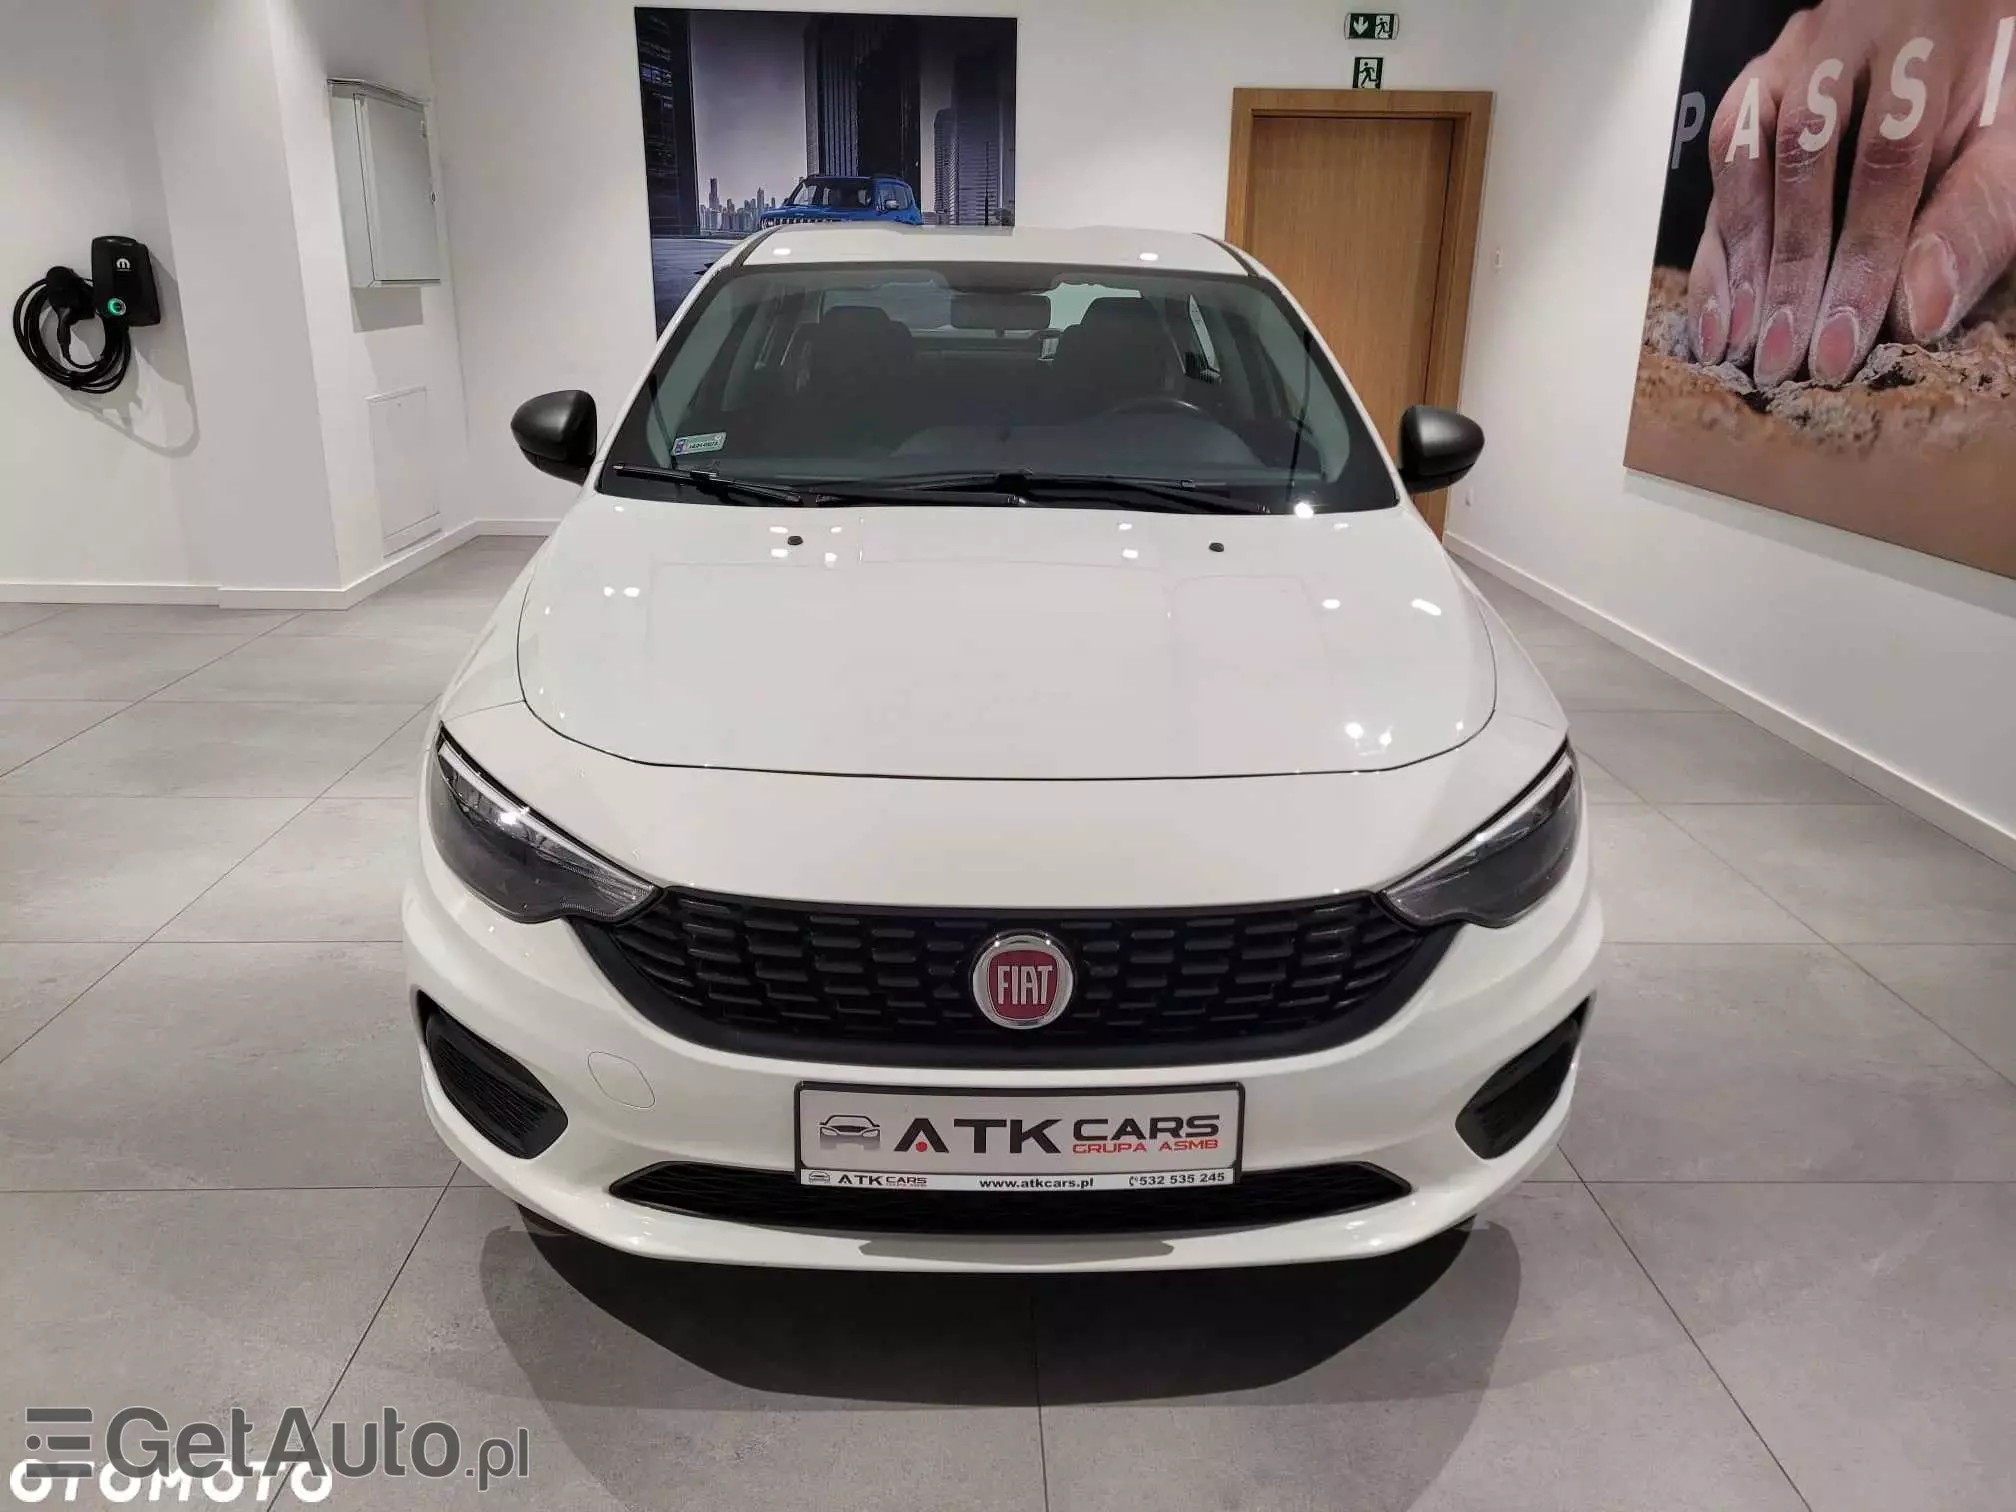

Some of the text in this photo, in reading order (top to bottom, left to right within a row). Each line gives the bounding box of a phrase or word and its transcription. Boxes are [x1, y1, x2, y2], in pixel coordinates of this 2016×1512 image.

[1671, 15, 2016, 170] PASSI
[997, 965, 1053, 1005] FIAT
[893, 1114, 1220, 1154] ATK CARS
[1072, 1139, 1219, 1154] GRUPA ASMB
[838, 1173, 884, 1186] ATK
[885, 1176, 928, 1184] CARS
[979, 1177, 1094, 1189] www.atkcars.pl
[1139, 1172, 1226, 1186] 532 535 245
